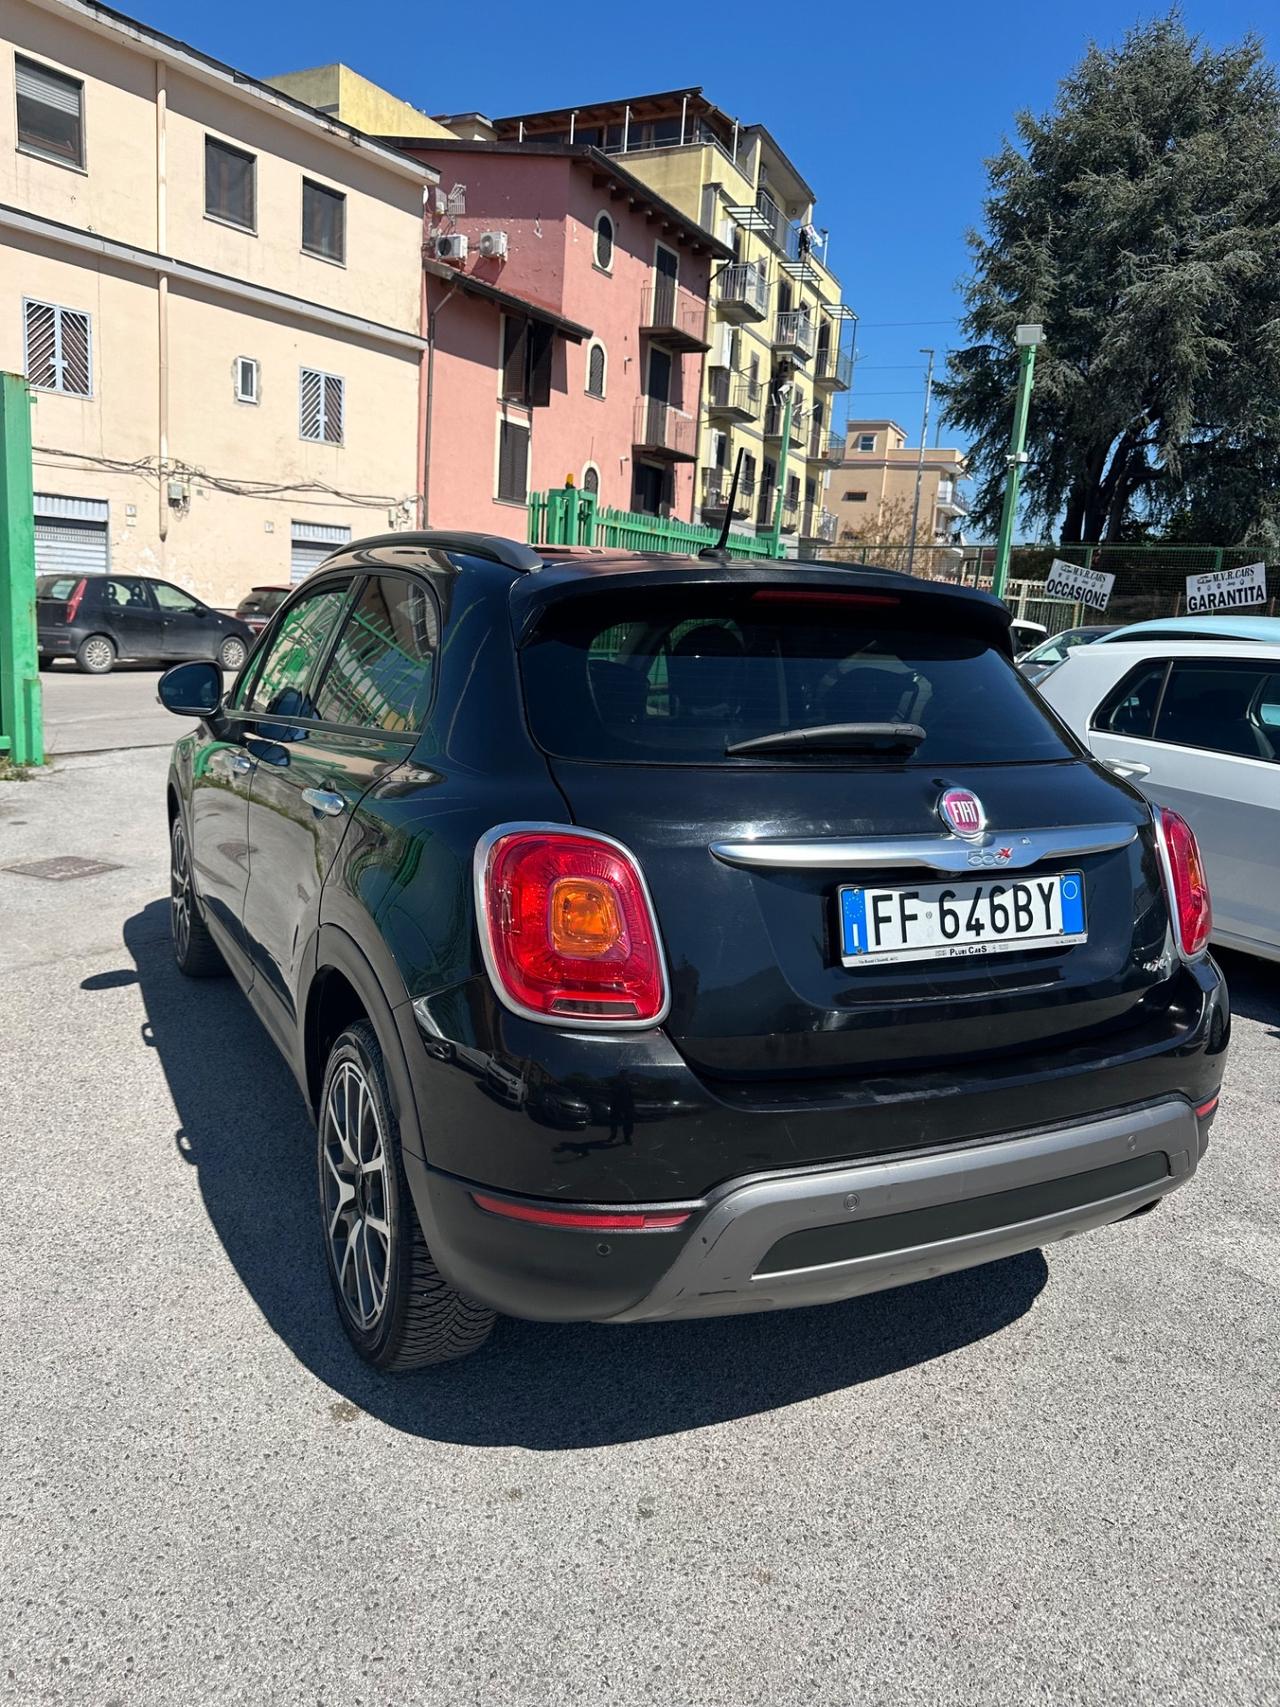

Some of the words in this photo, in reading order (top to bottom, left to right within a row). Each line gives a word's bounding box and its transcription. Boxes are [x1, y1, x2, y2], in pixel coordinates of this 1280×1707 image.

[1046, 579, 1107, 608] OCCASIONE
[1188, 585, 1264, 612] GARANTITA
[950, 801, 978, 823] FIAT
[872, 892, 919, 946] FF
[938, 881, 1055, 940] 646BY
